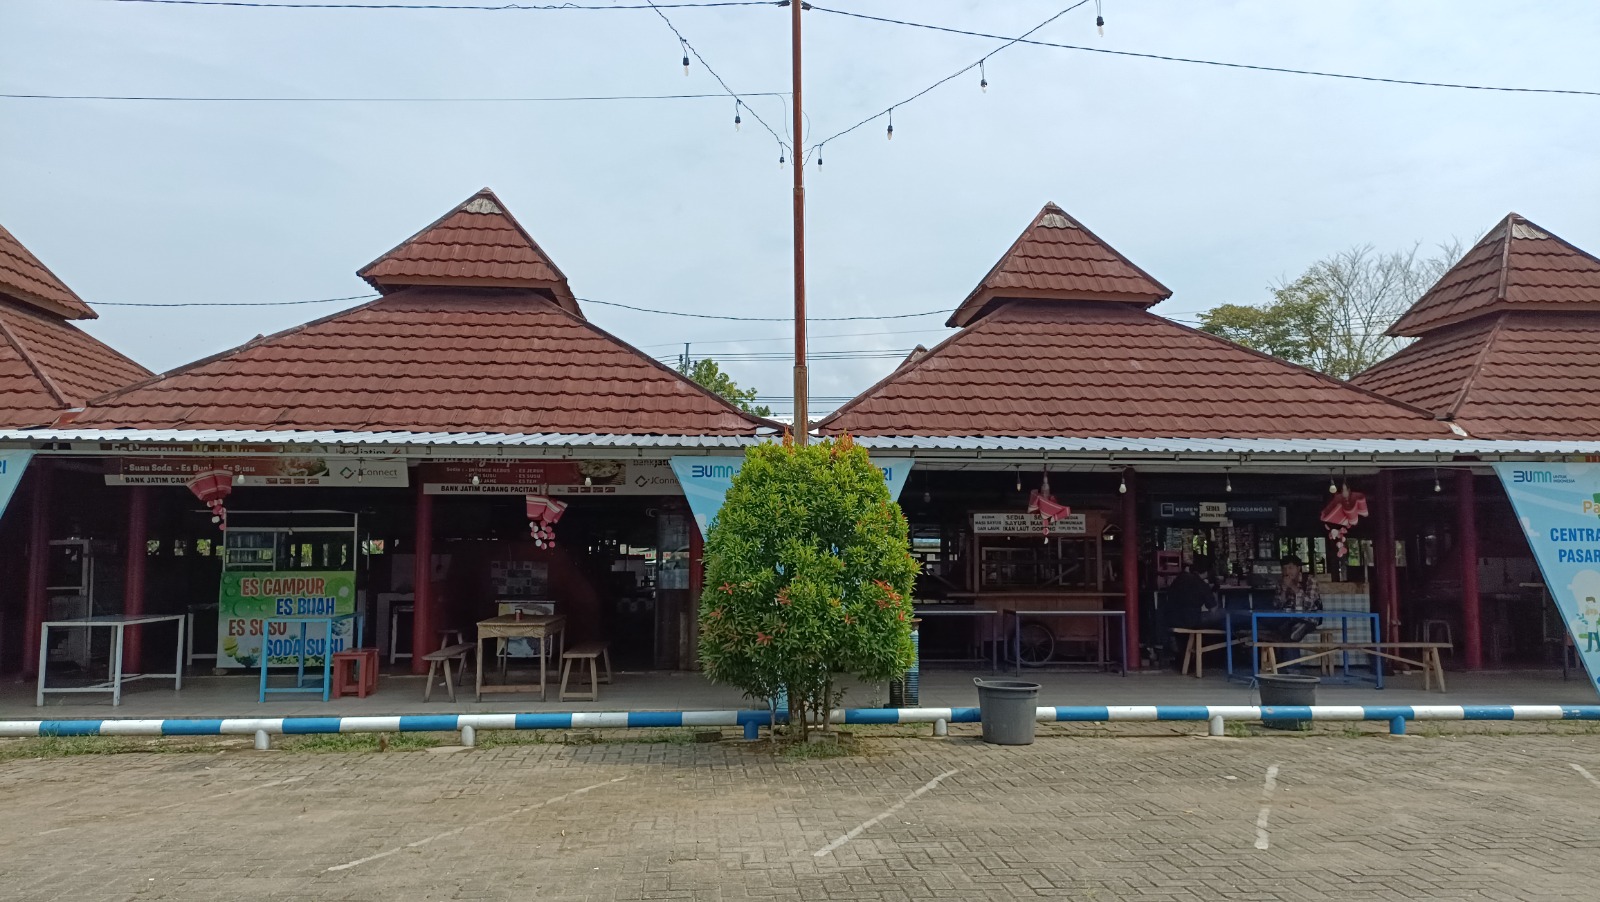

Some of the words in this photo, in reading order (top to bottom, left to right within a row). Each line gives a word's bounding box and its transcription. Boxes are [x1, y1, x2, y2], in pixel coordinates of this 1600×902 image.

[129, 464, 150, 472] Susu
[151, 464, 173, 472] Soda
[181, 464, 192, 472] Es
[242, 578, 259, 596] ES
[263, 577, 325, 596] CAMPUR
[276, 597, 293, 615] ES
[297, 597, 335, 615] BUAH
[228, 619, 246, 636] ES
[267, 639, 301, 657] SODA
